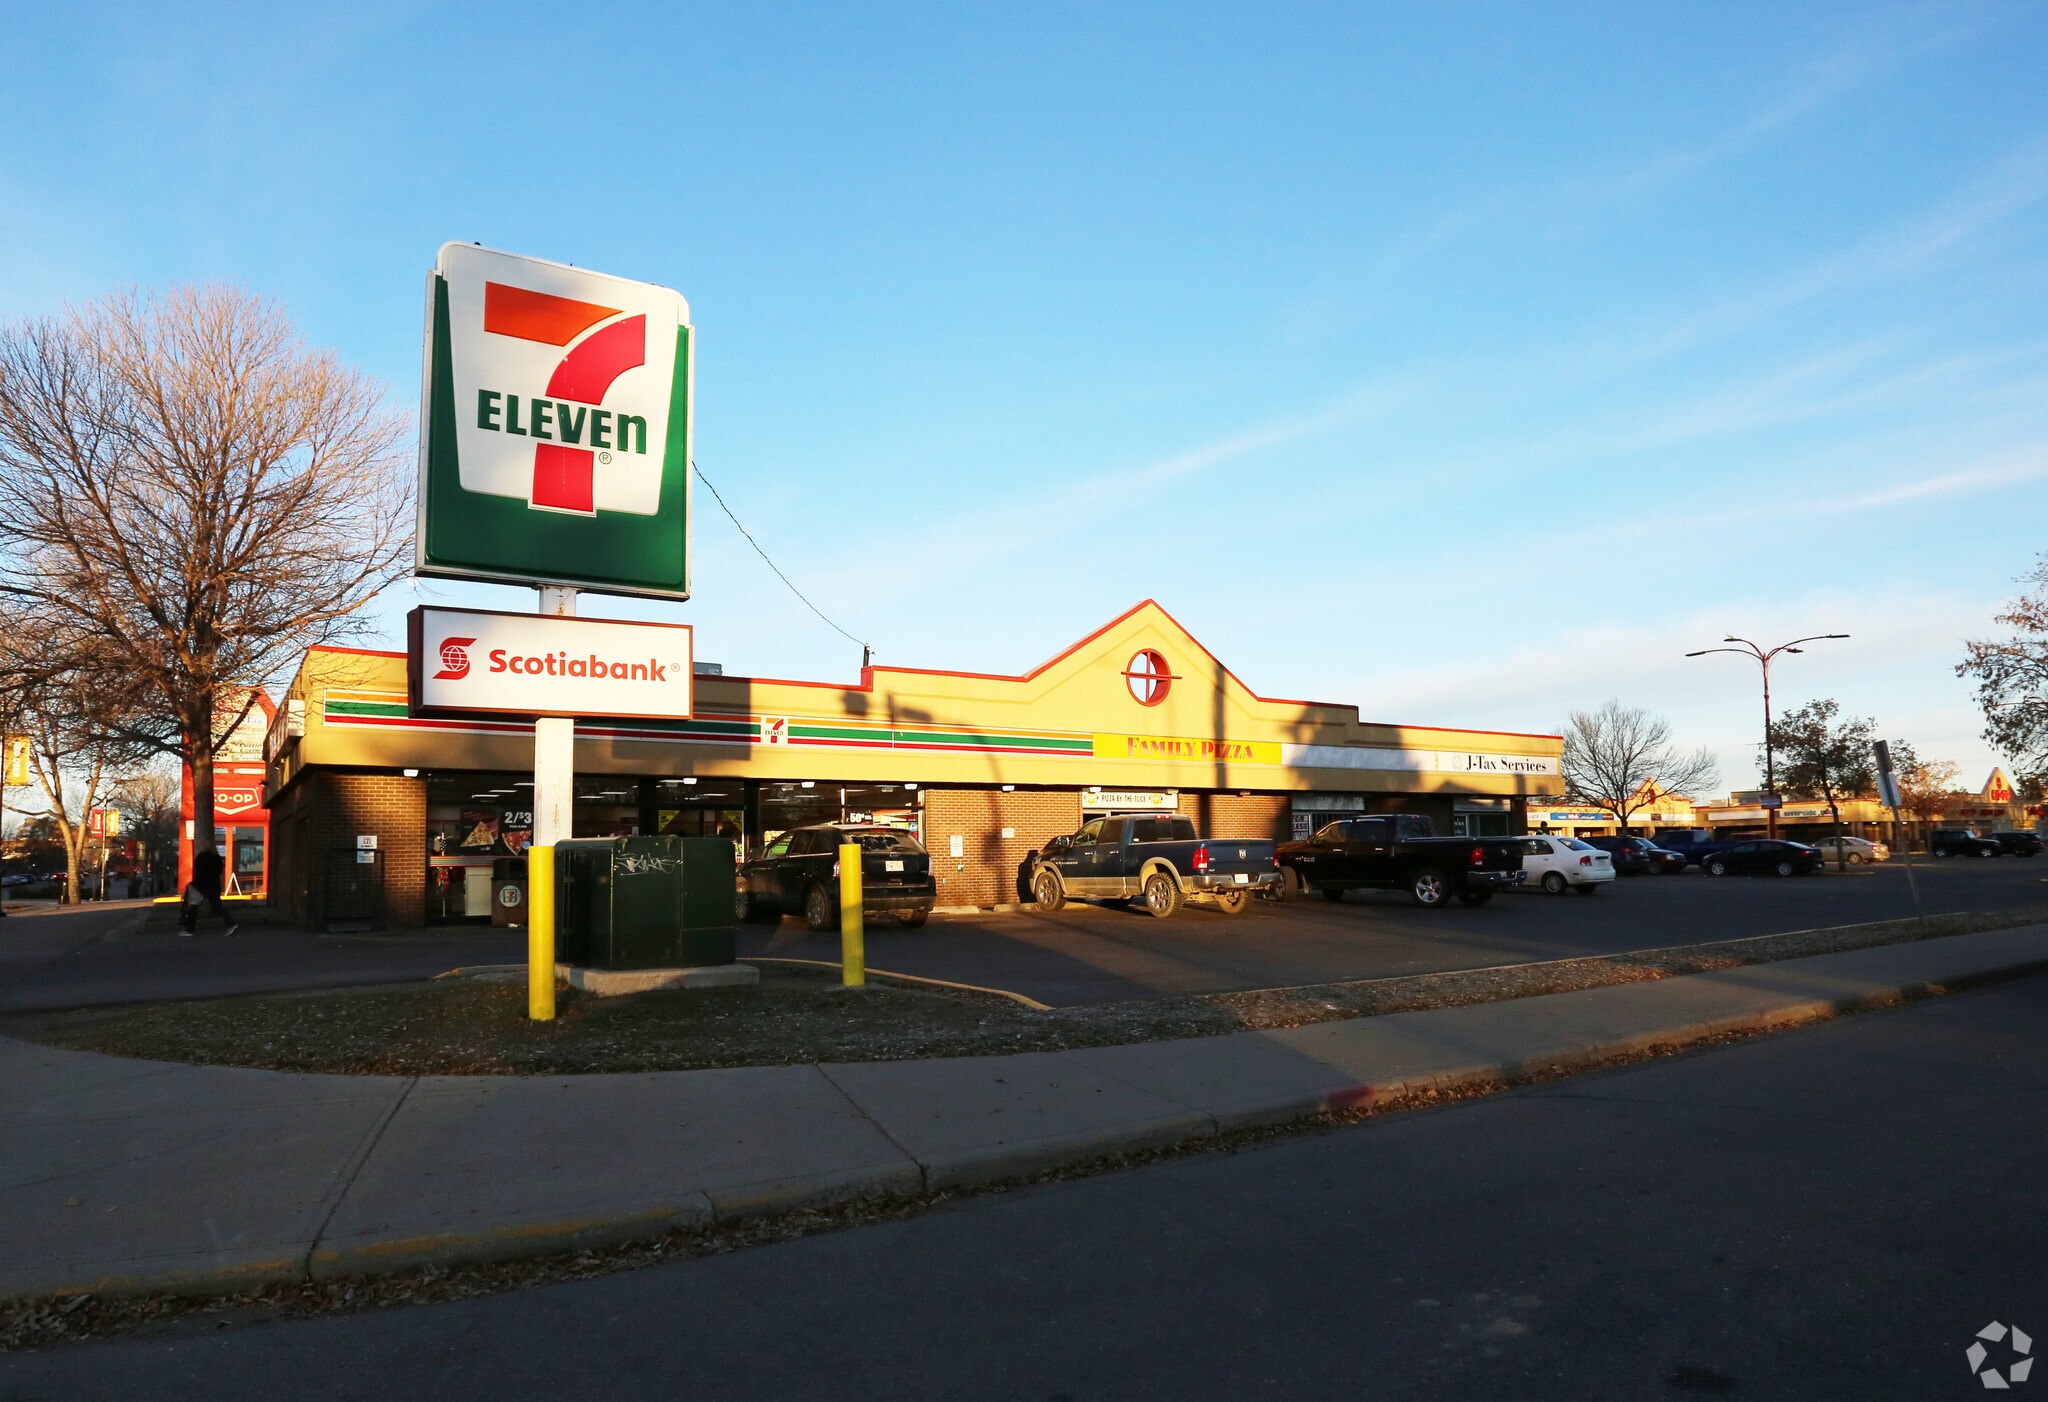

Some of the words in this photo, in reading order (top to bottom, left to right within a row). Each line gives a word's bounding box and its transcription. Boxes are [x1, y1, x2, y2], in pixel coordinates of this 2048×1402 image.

[484, 280, 646, 512] 7
[488, 649, 667, 683] Scotiabank
[1127, 737, 1197, 757] FAMILY
[1200, 741, 1254, 759] PIZZA
[1466, 755, 1497, 771] J-Tax
[1501, 757, 1547, 773] Services
[1101, 794, 1115, 802] PIZZA
[1116, 794, 1123, 802] BY
[1124, 794, 1133, 802] THE
